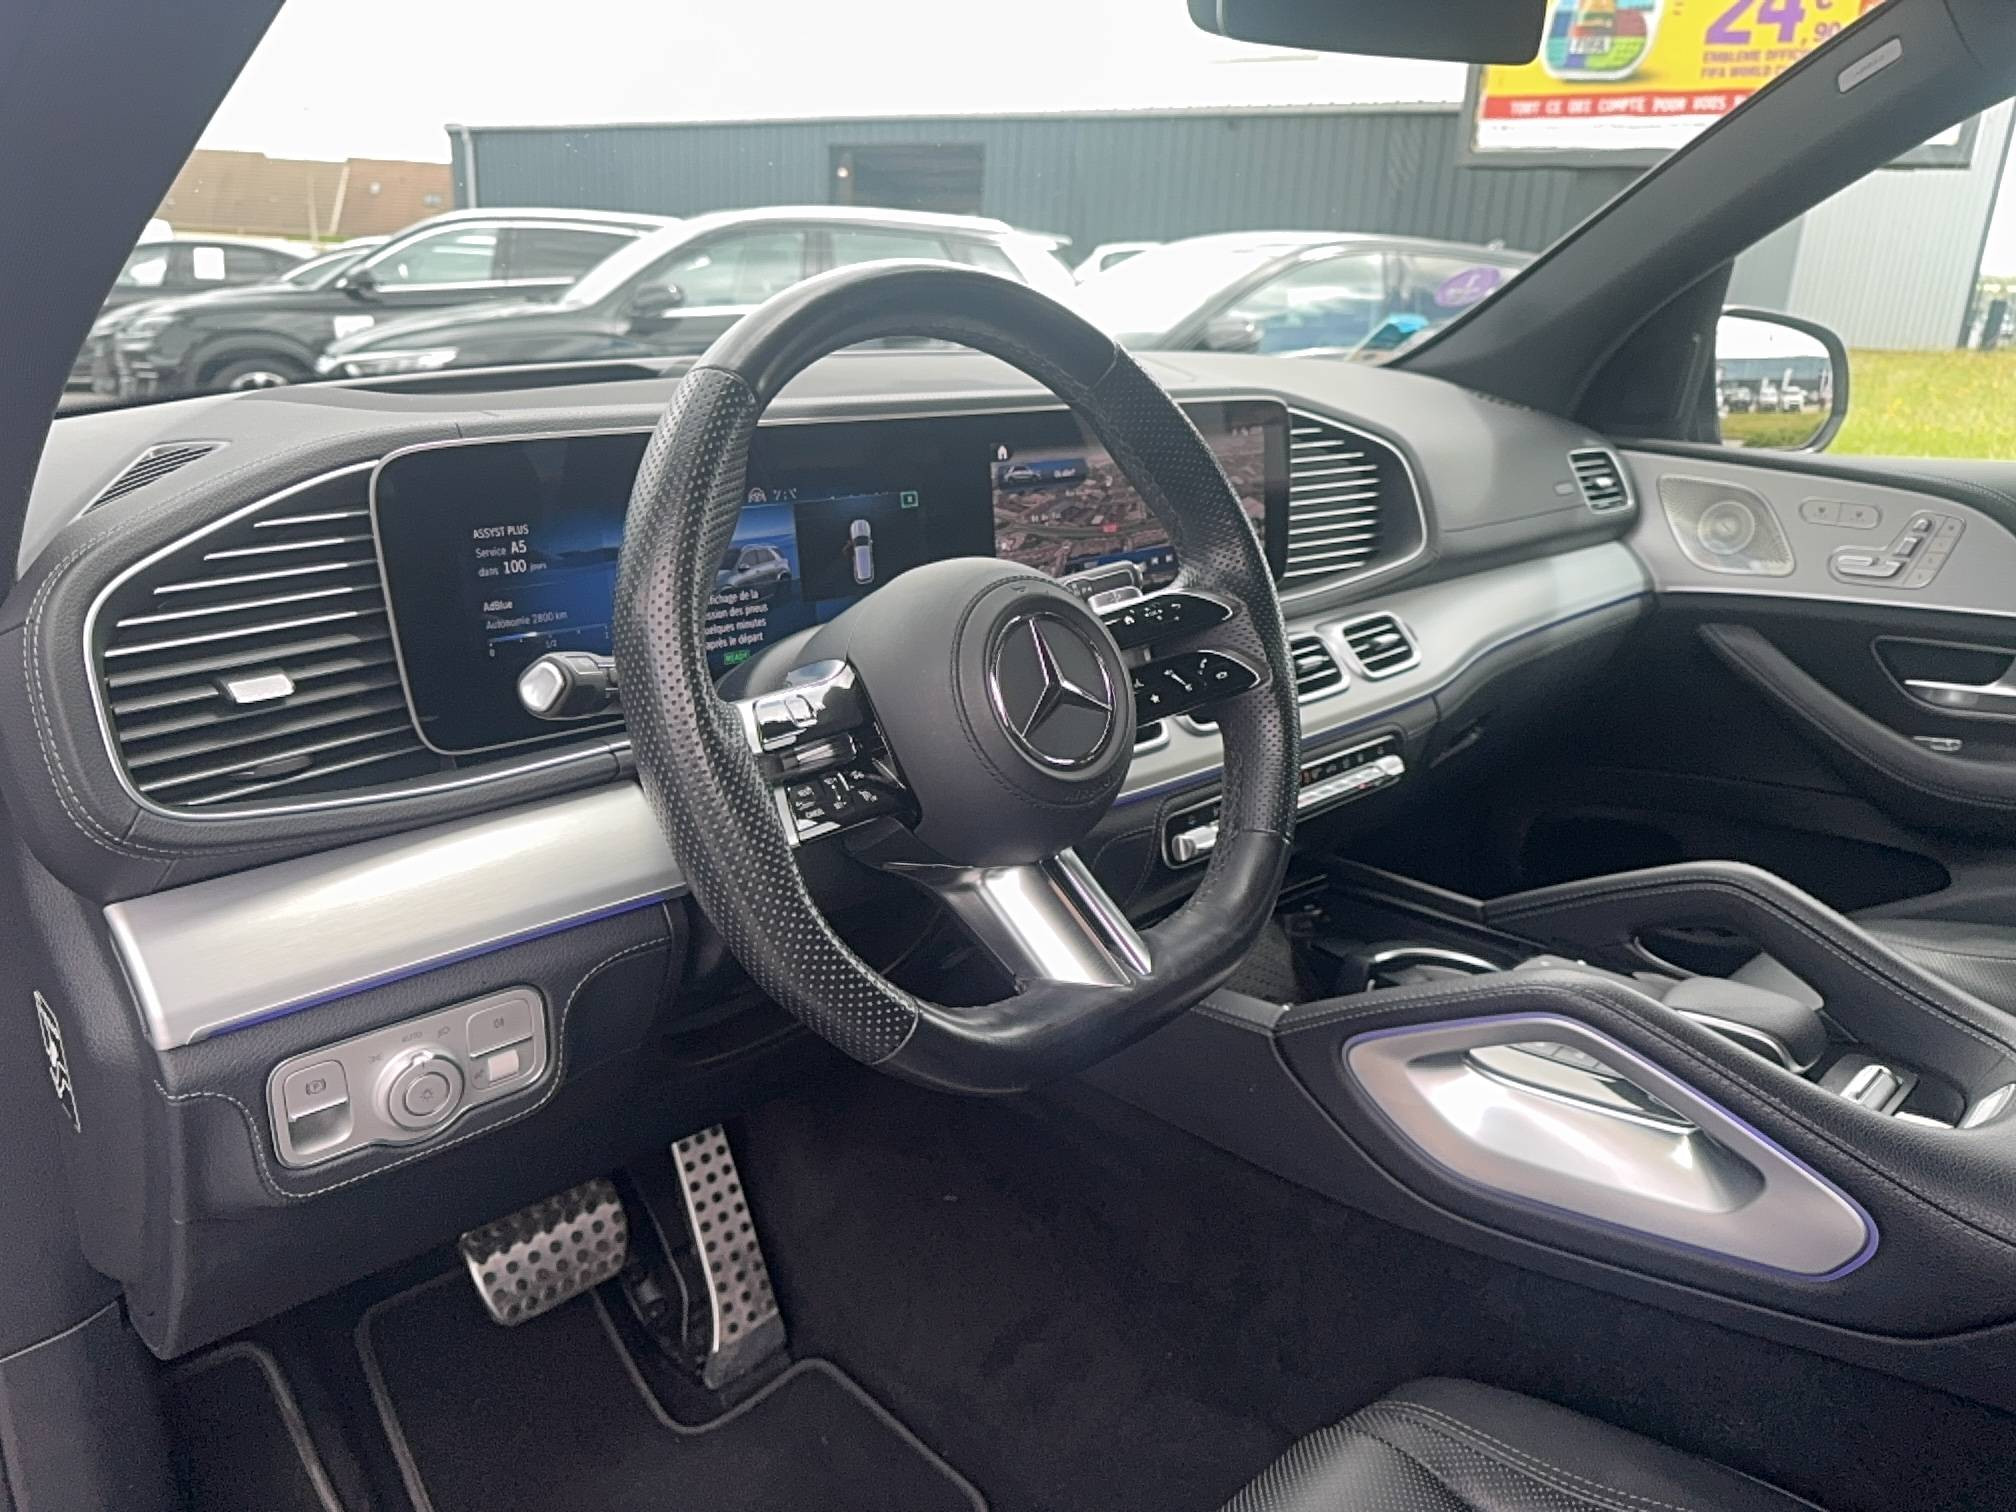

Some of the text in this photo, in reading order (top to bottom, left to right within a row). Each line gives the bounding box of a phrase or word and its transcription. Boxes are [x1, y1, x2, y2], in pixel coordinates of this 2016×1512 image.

[1705, 0, 1806, 45] 24
[1597, 96, 1648, 113] COMPTE
[473, 524, 529, 539] ASSYST PLUS
[475, 539, 528, 558] Service A5
[478, 567, 500, 578] dans
[503, 559, 528, 575] 100
[740, 590, 750, 601] de
[483, 600, 513, 612] AdBlue
[729, 606, 744, 617] des
[745, 604, 768, 616] pneus
[486, 617, 531, 630] Autonomie
[555, 611, 568, 620] km
[736, 618, 767, 631] minutes
[738, 632, 764, 646] départ
